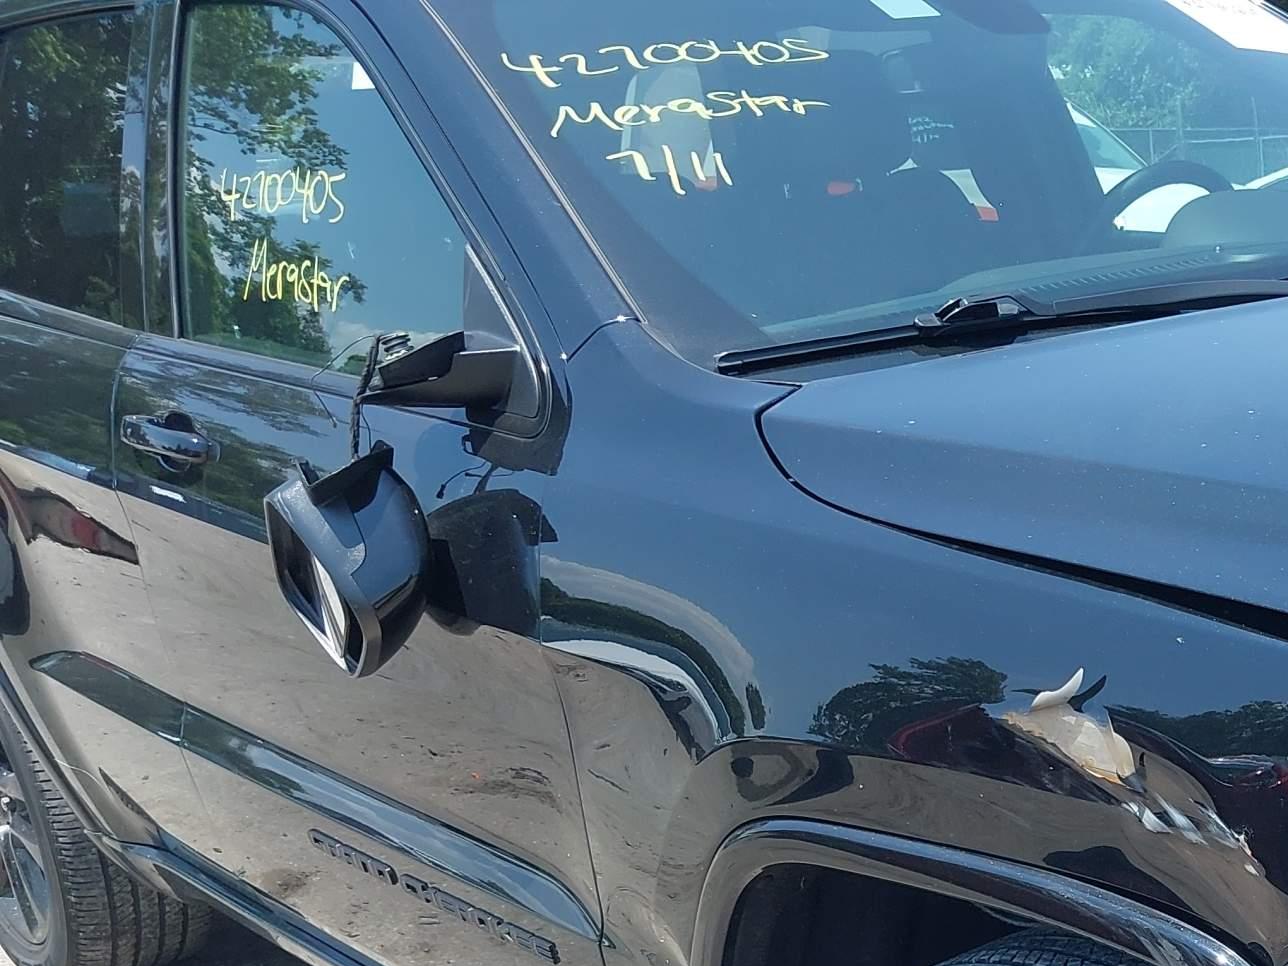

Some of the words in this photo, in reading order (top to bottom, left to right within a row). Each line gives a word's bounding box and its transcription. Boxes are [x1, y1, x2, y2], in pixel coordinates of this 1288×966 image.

[501, 38, 830, 88] 42700405
[220, 166, 346, 224] 42700405
[606, 144, 733, 196] 7/11
[307, 828, 398, 886] GRAND
[400, 872, 561, 965] CHEROKEE
